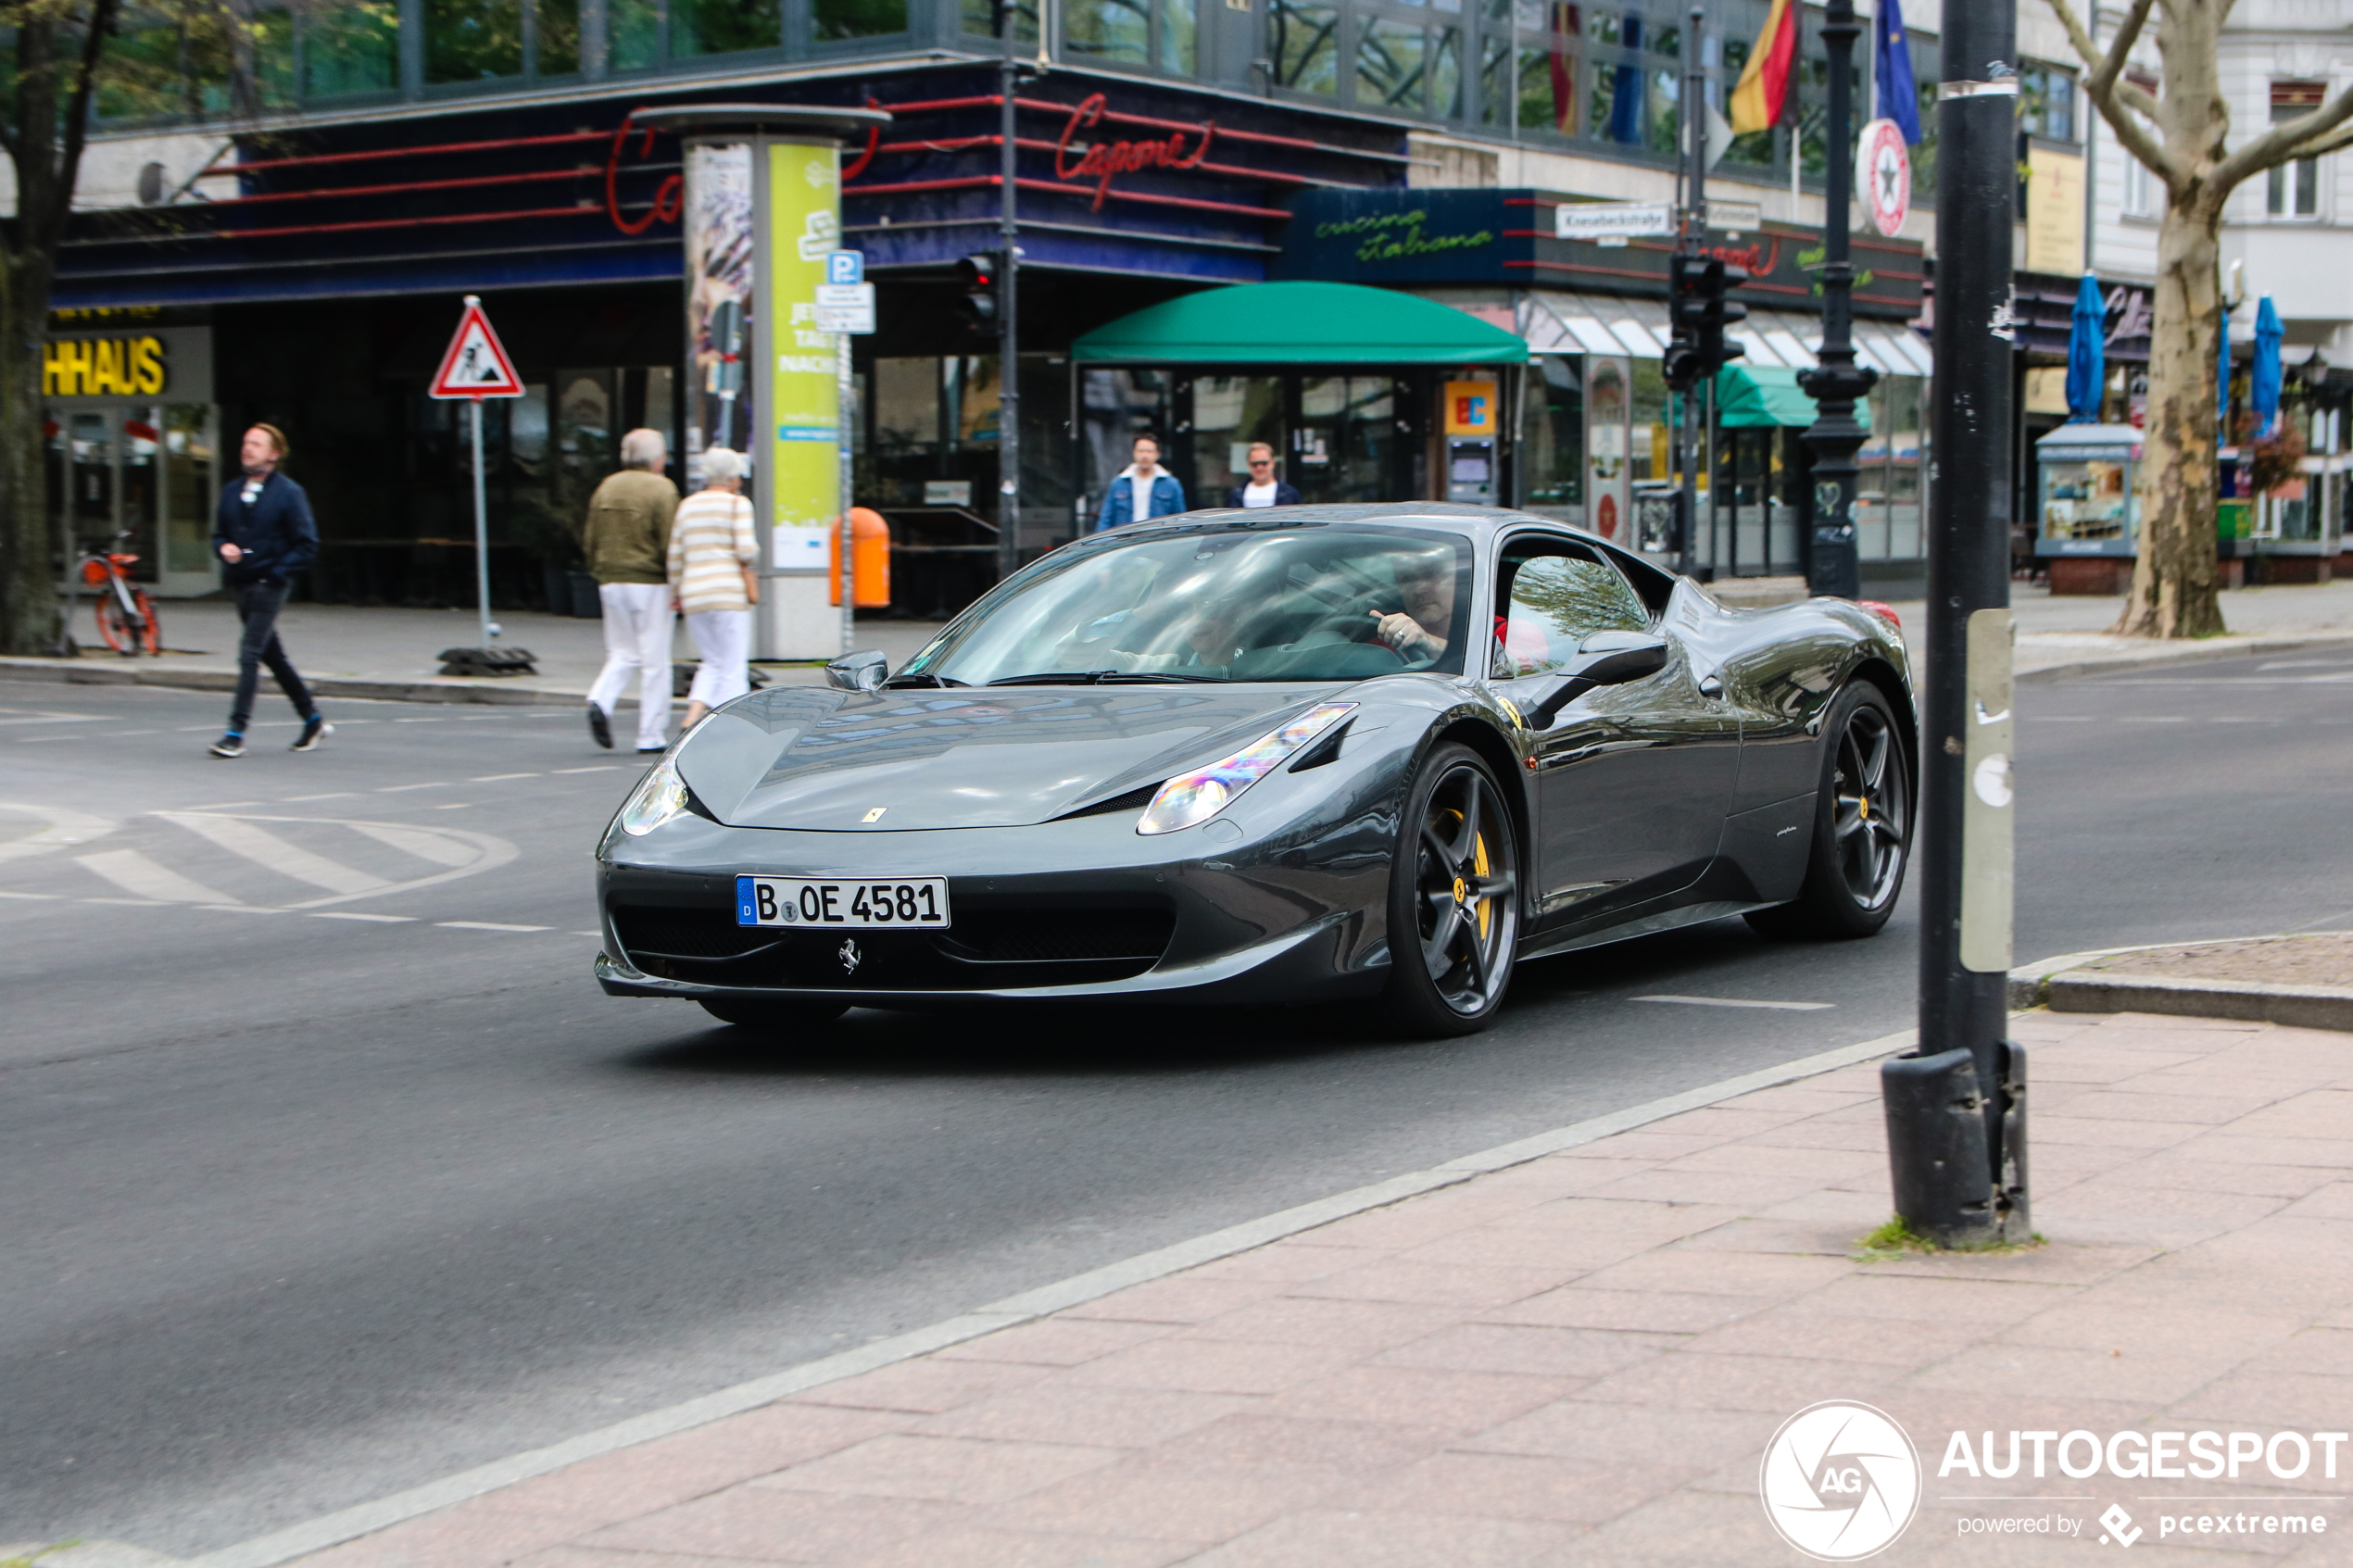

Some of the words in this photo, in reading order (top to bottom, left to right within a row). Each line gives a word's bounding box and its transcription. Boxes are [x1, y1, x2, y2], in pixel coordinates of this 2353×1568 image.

[1055, 93, 1216, 212] Capone
[833, 256, 854, 282] P
[1456, 396, 1485, 424] EC
[743, 905, 751, 916] D
[756, 884, 778, 921] B
[799, 884, 844, 922] OE
[851, 884, 941, 922] 4581
